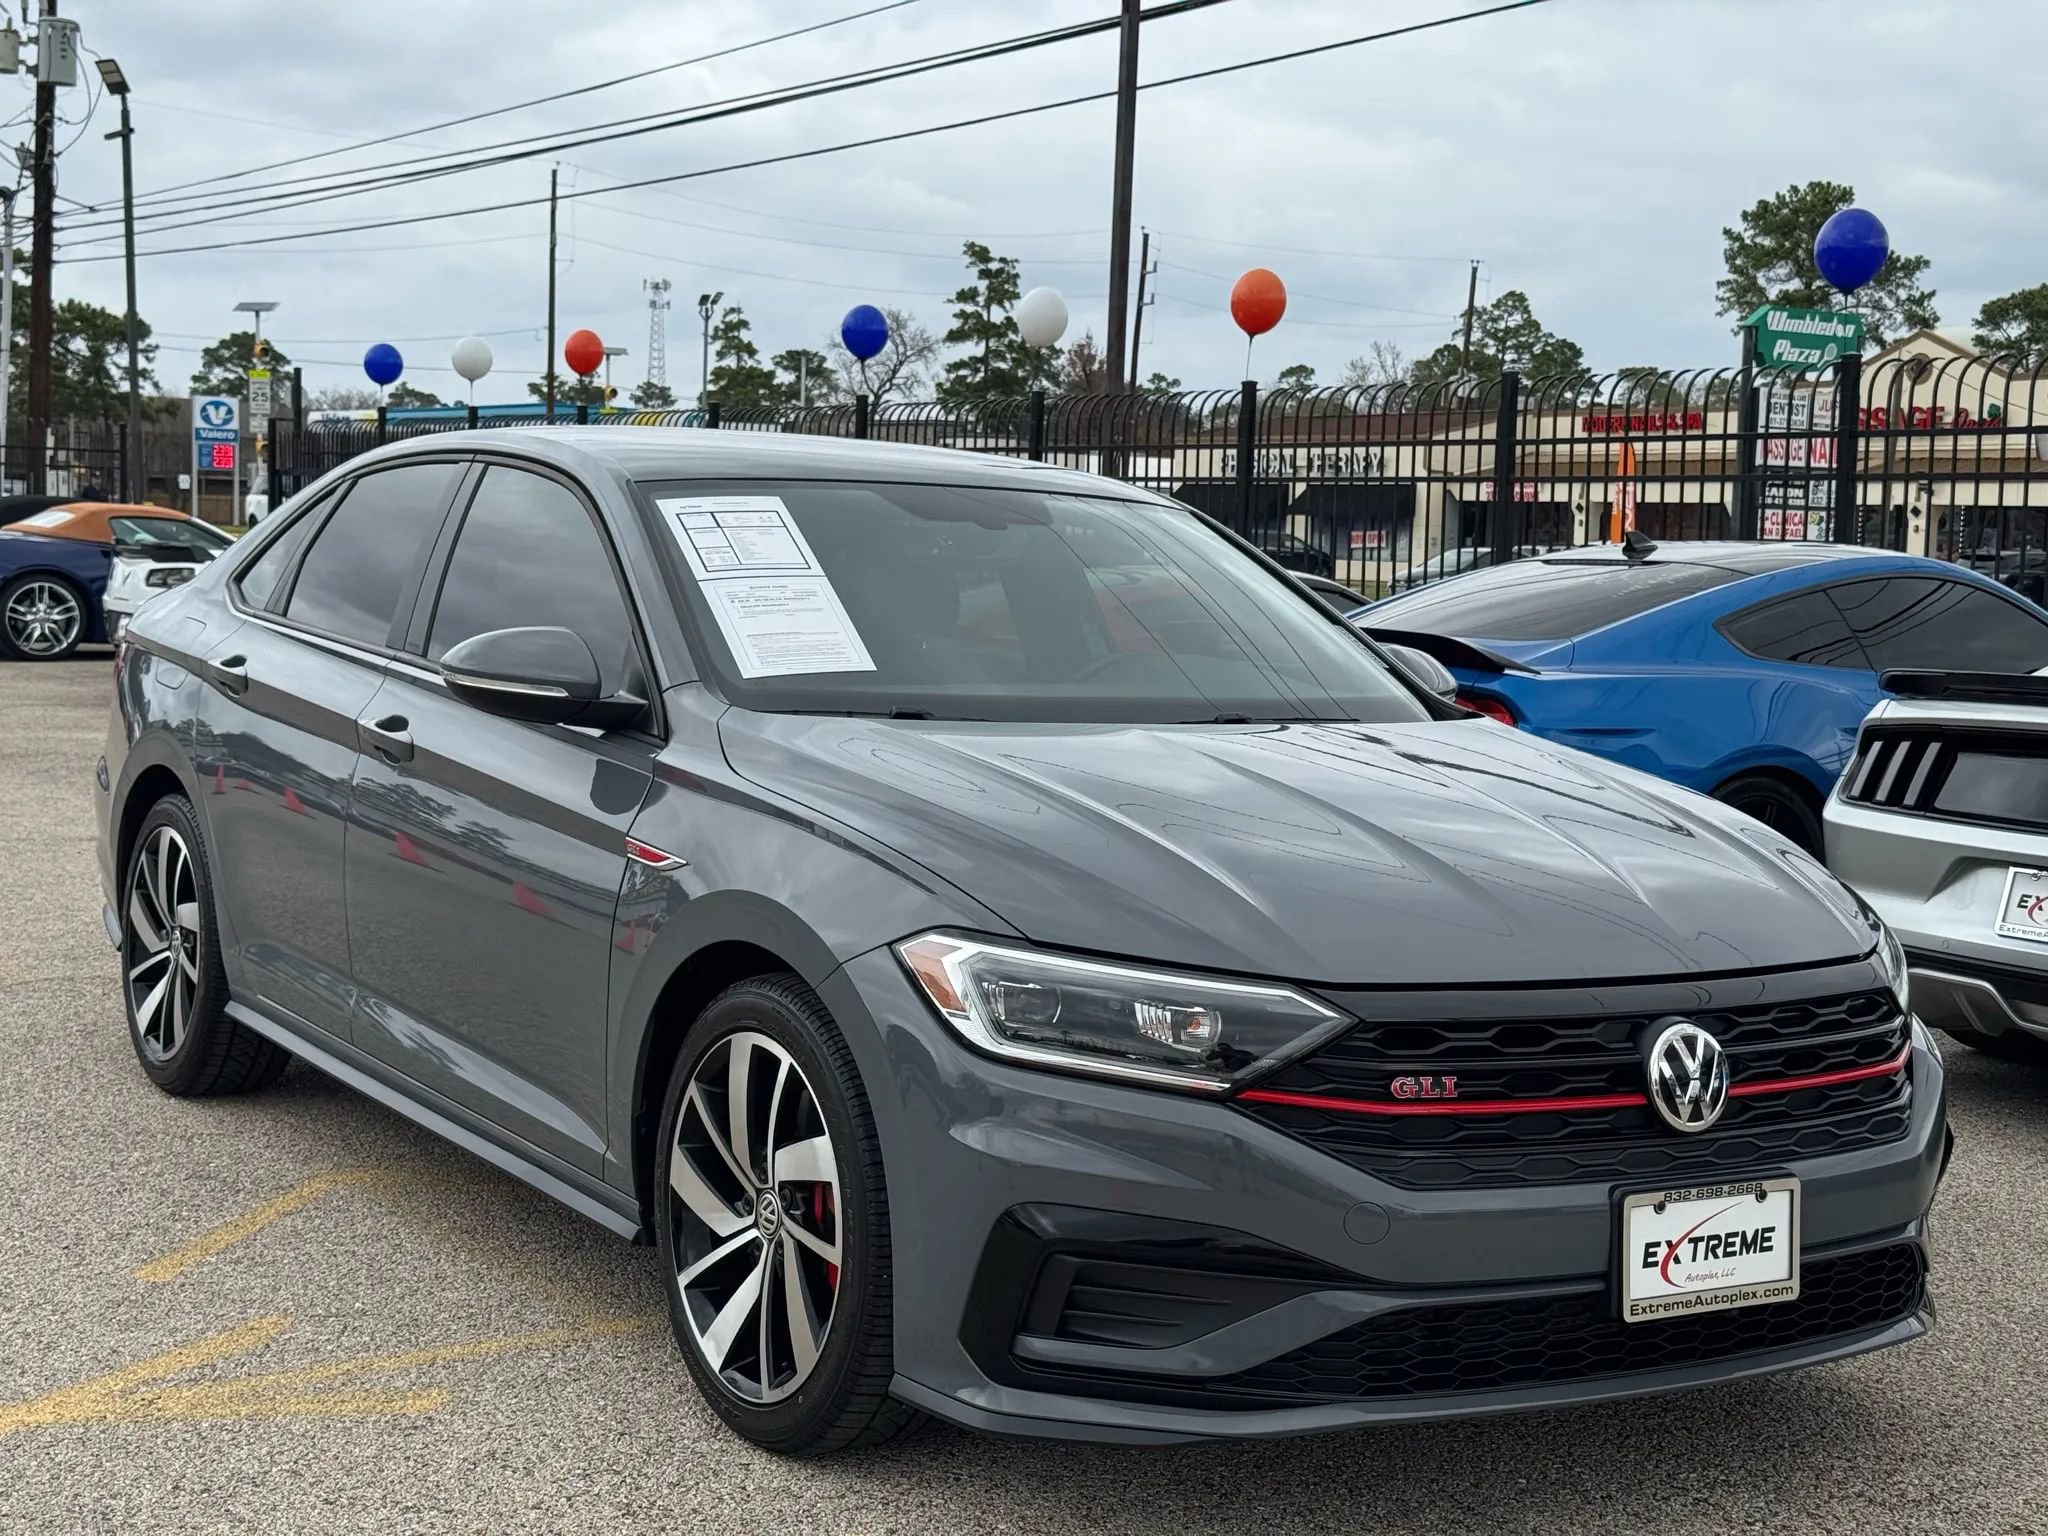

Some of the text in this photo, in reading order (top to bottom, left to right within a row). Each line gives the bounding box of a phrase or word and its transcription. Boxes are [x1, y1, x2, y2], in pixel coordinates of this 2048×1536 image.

[1766, 310, 1856, 338] Wimbledon
[1772, 338, 1821, 364] Plaza
[252, 392, 269, 403] 25
[199, 429, 236, 440] Valero
[1760, 438, 1804, 462] ASSGE
[1391, 1076, 1458, 1099] GLI
[1642, 1226, 1776, 1269] EXTREME
[1721, 1267, 1737, 1279] LLC
[1630, 1285, 1794, 1317] ExtremeAutoplex.com
